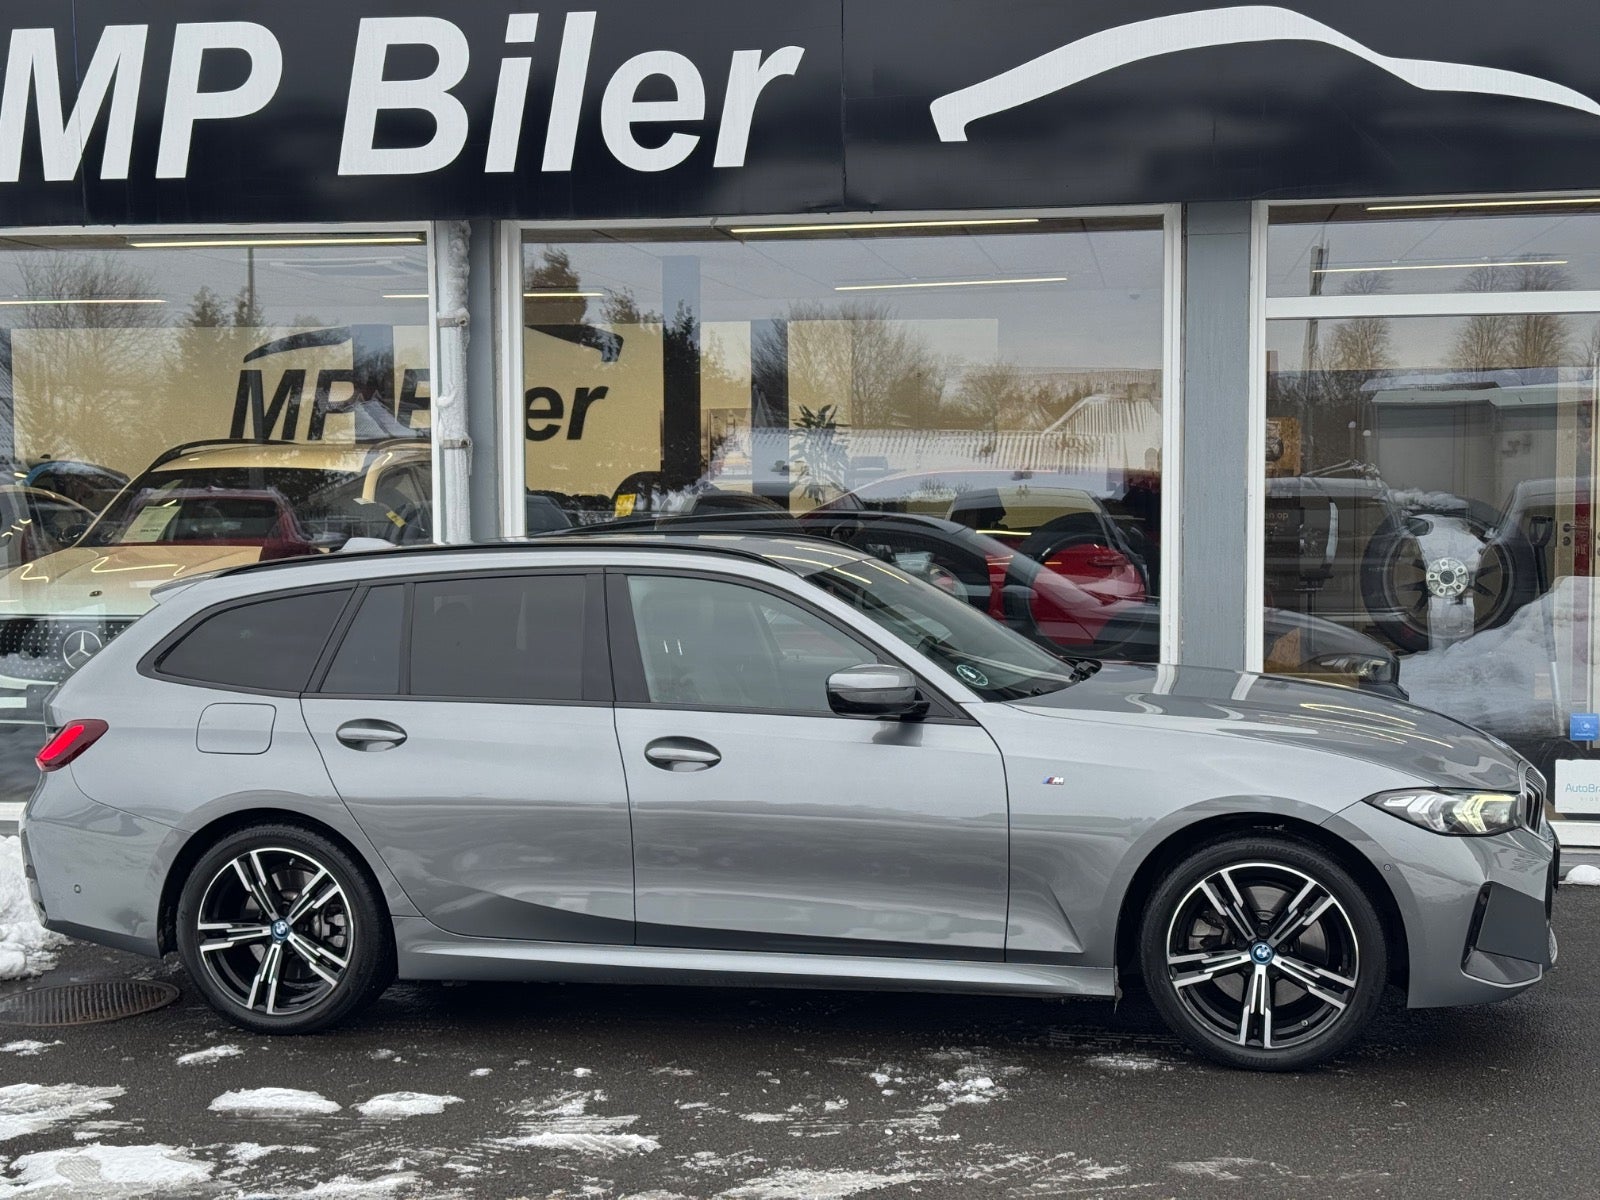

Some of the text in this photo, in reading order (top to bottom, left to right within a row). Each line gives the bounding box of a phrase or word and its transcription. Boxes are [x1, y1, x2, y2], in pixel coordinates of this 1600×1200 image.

[0, 10, 806, 184] MP Biler
[229, 368, 374, 441] MP
